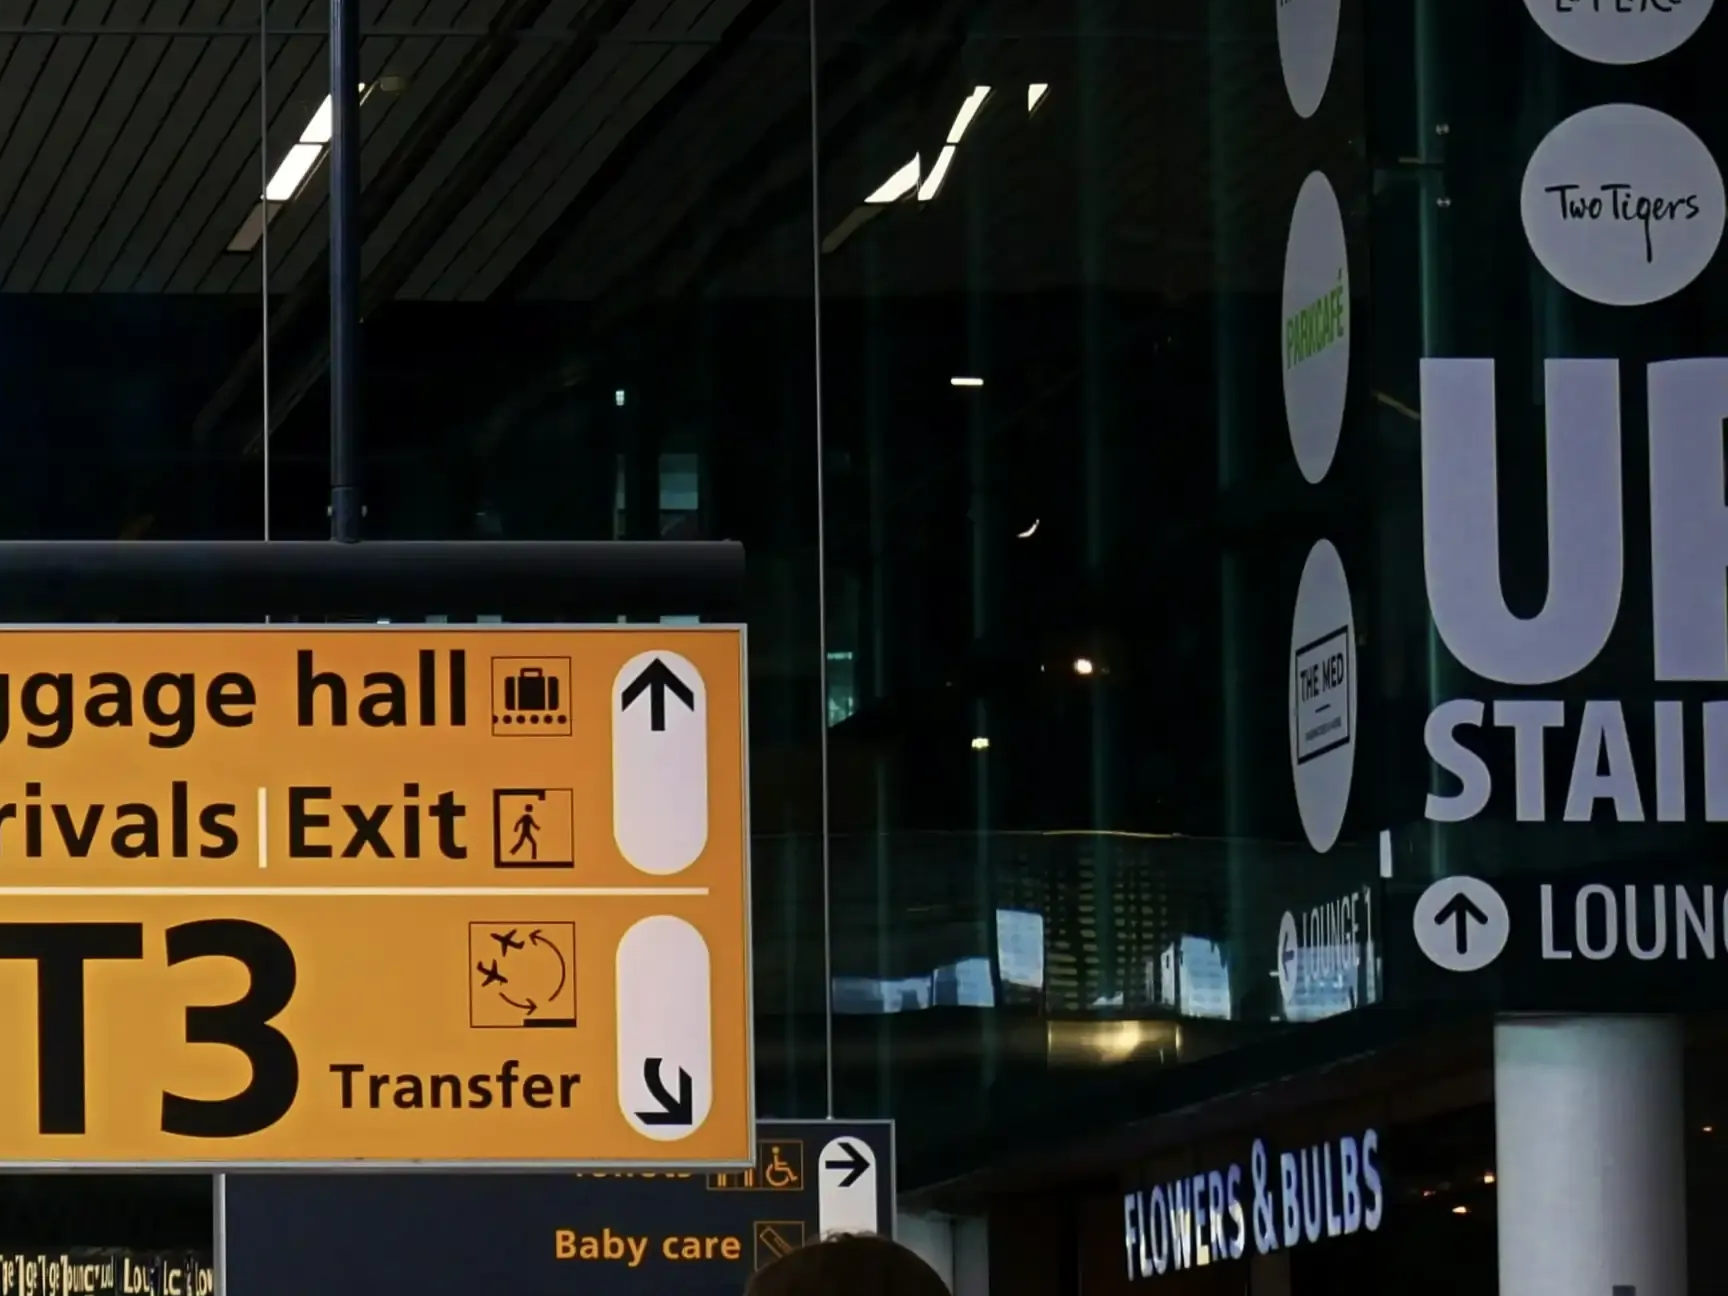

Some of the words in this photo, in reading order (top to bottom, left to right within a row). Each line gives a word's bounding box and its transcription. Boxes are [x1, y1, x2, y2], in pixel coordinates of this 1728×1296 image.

[296, 649, 467, 727] hall
[1300, 664, 1319, 702] THE
[1322, 652, 1344, 692] MED
[1423, 697, 1728, 823] STAI
[287, 783, 467, 859] Exit
[1302, 892, 1360, 980] LOUNGE
[1540, 882, 1728, 961] LOUN
[330, 1061, 580, 1109] Transfer
[1124, 1162, 1245, 1282] FLOWERS
[1251, 1137, 1279, 1255] &
[1280, 1128, 1383, 1249] BULBS
[555, 1227, 648, 1267] Baby
[662, 1235, 742, 1260] care
